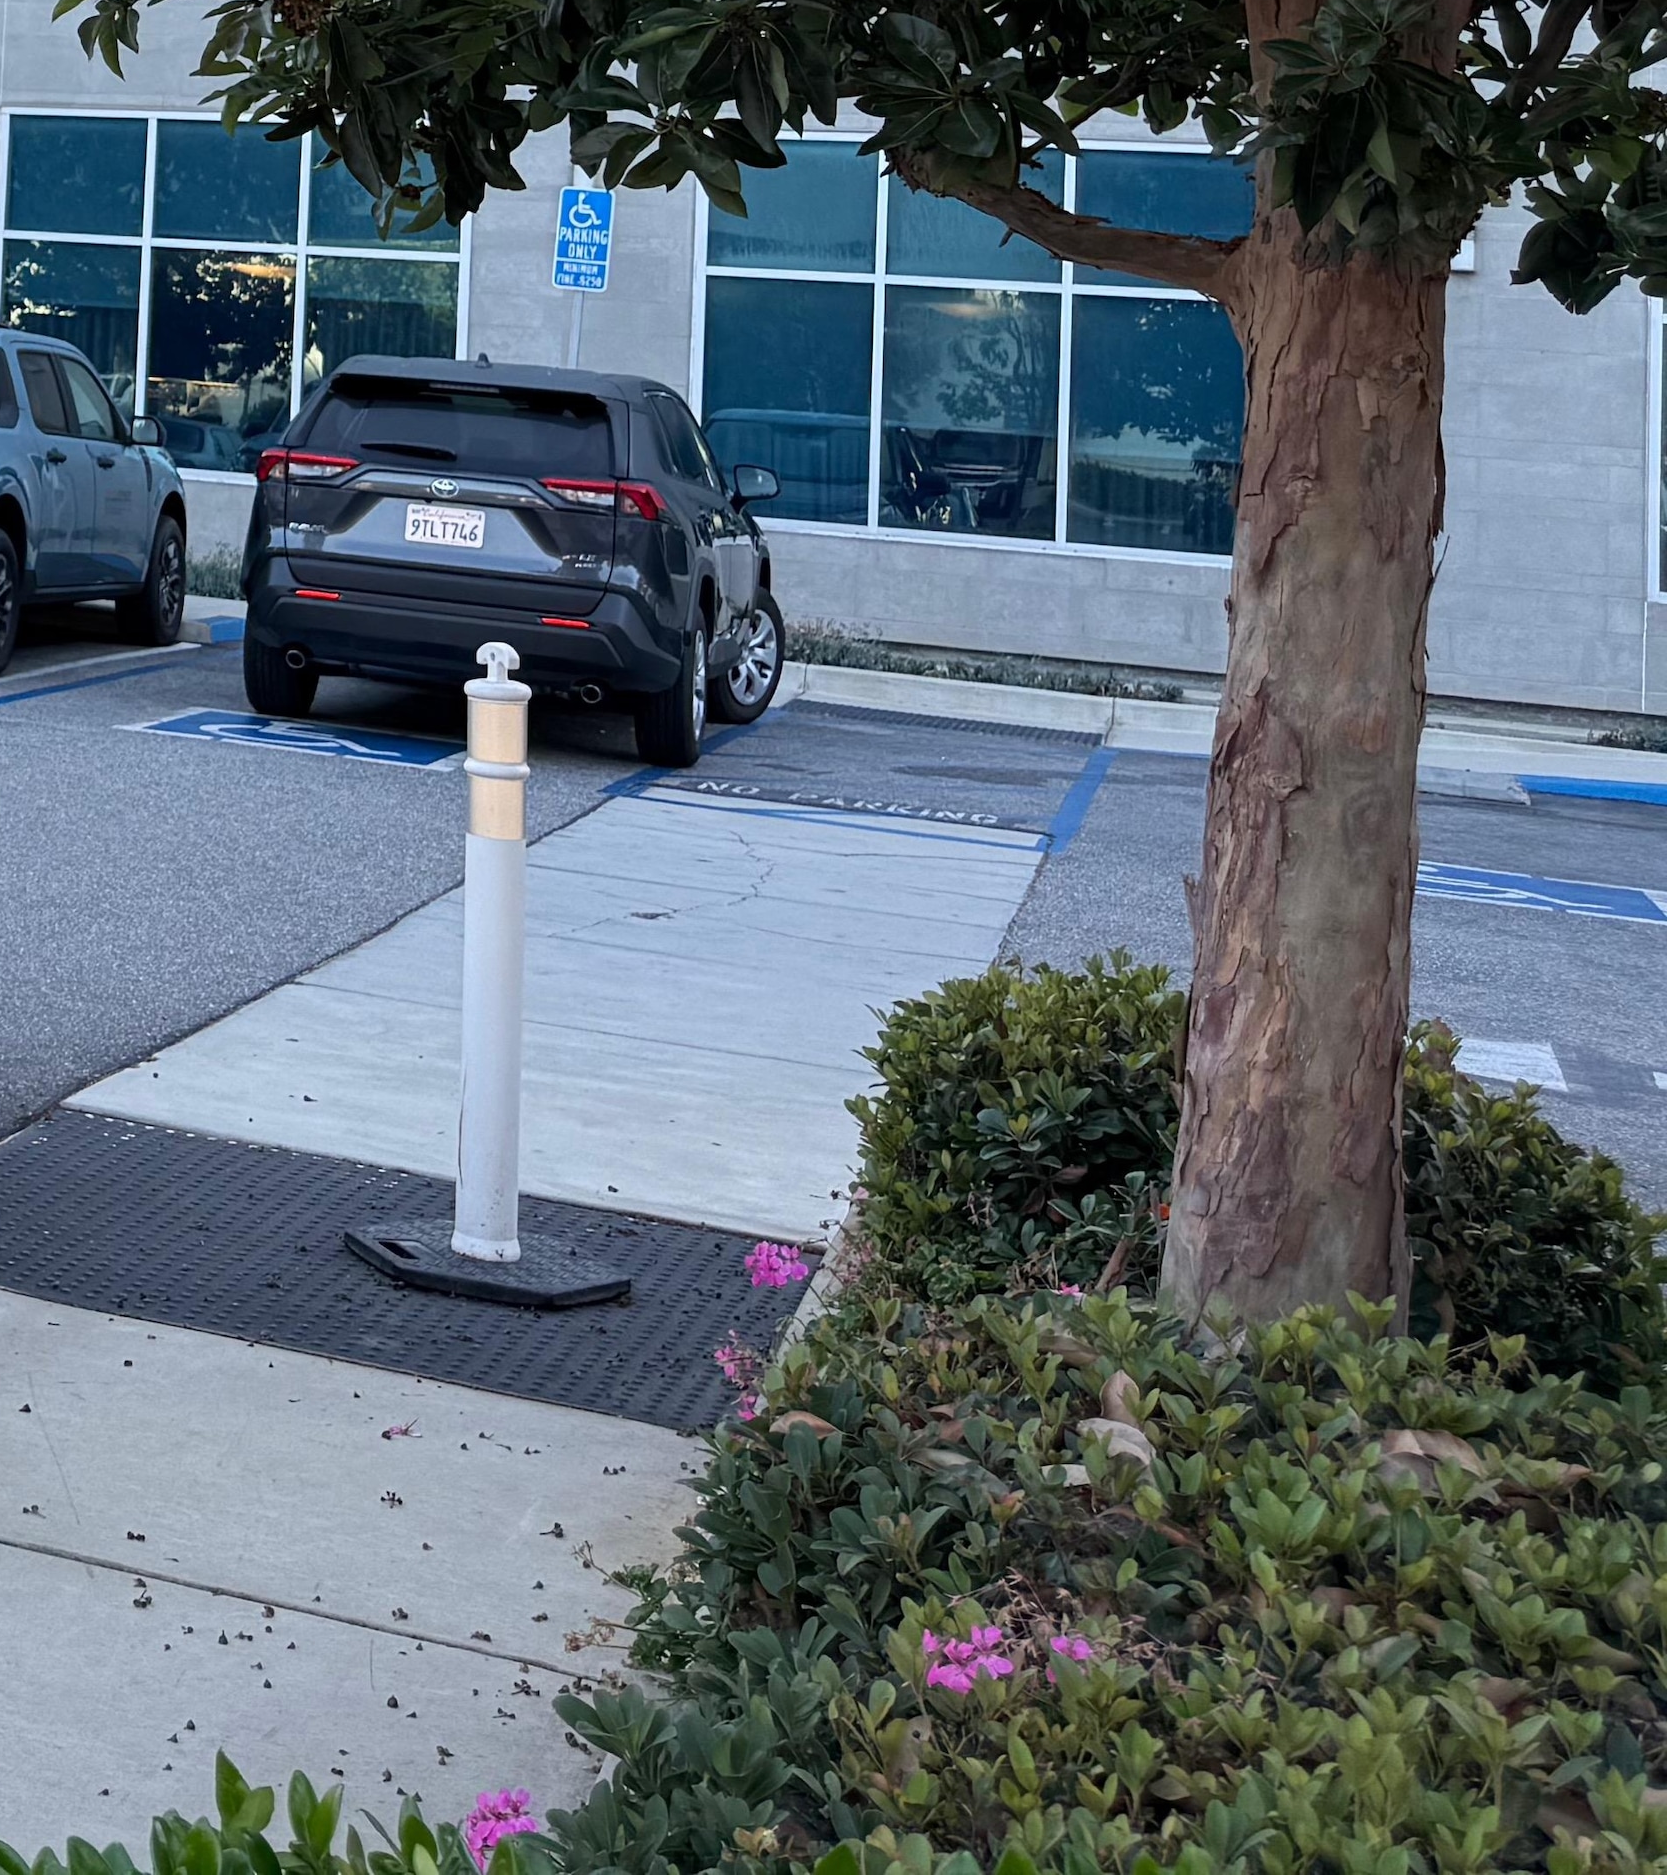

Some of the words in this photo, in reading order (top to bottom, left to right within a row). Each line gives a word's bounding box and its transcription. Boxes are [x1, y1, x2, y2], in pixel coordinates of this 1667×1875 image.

[559, 226, 608, 245] PARKING
[568, 242, 597, 260] ONLY
[411, 518, 479, 542] 9TLT746
[697, 780, 761, 796] NO
[787, 791, 1000, 825] PARKING
